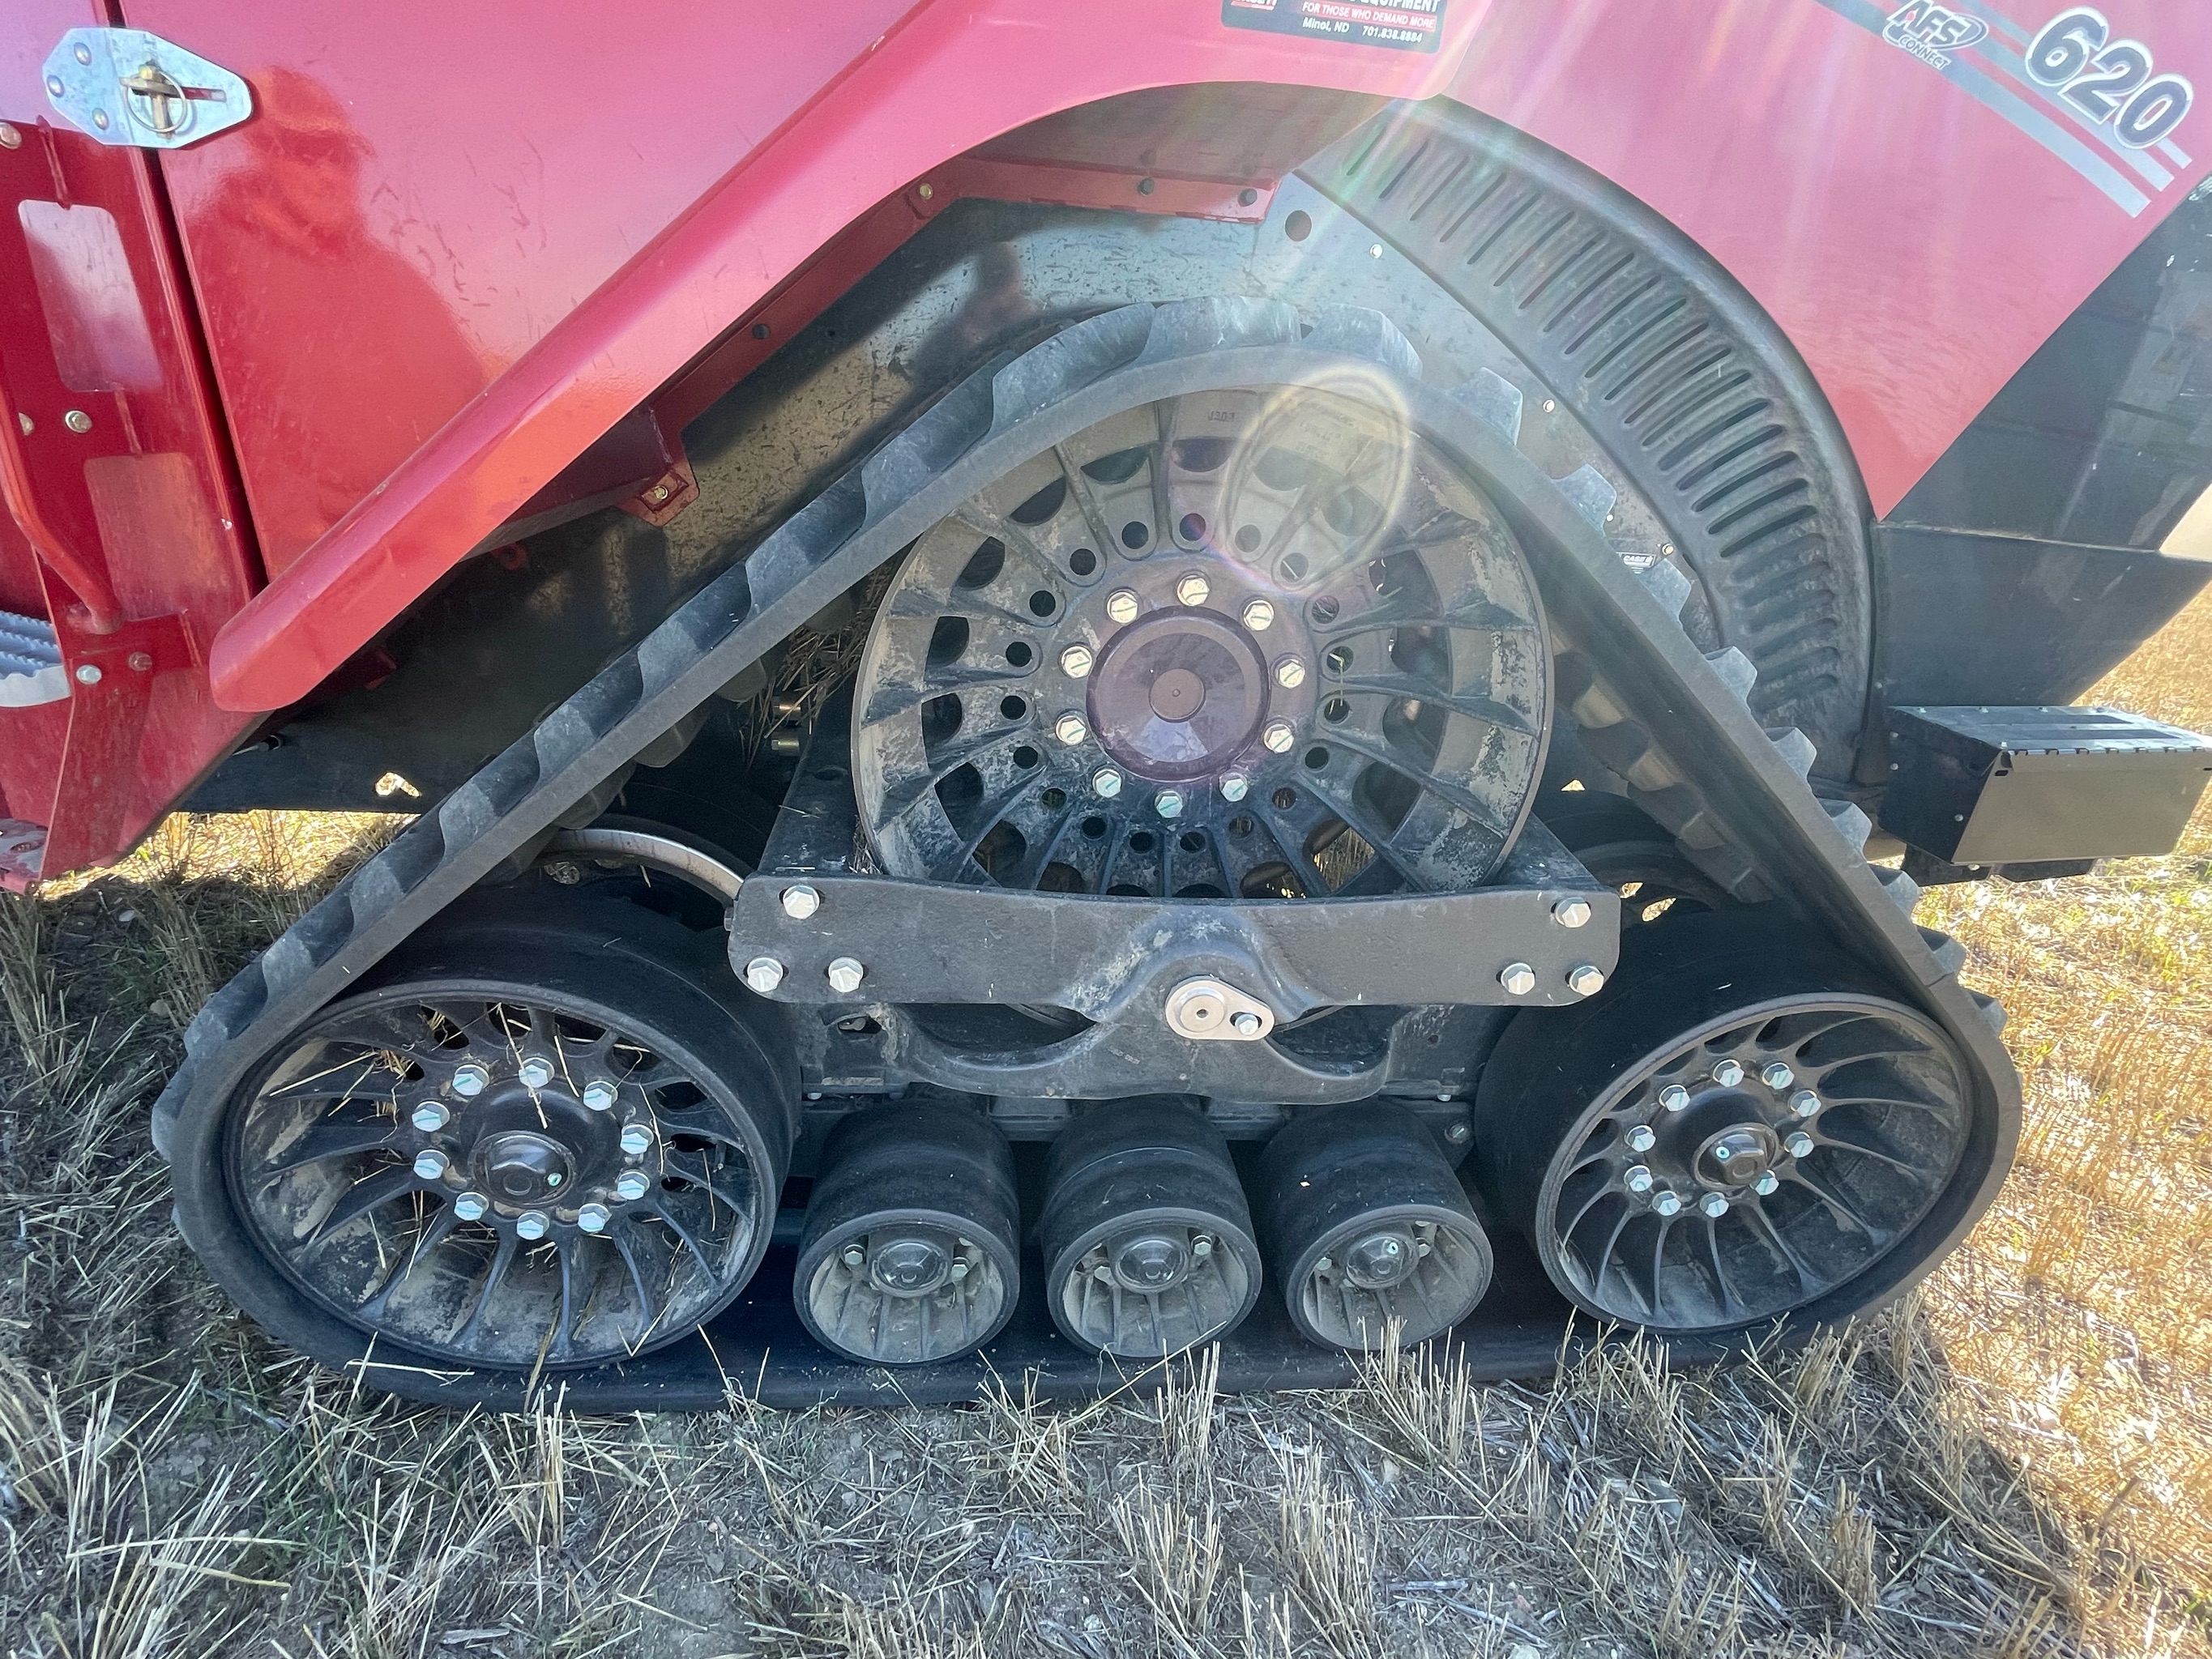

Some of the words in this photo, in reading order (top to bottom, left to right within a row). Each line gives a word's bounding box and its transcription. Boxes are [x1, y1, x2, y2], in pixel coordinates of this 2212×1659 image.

[1302, 2, 1321, 14] FOR
[1322, 4, 1351, 18] THOSE
[1351, 8, 1372, 21] WHO
[1373, 11, 1409, 25] DEMAND
[1409, 16, 1435, 28] MORE
[1361, 0, 1441, 12] IPMENT
[1302, 17, 1331, 32] Minot,
[1334, 21, 1350, 33] ND
[1886, 0, 1972, 45] AFS
[1898, 34, 1951, 70] CONNECT
[2026, 6, 2193, 149] 620
